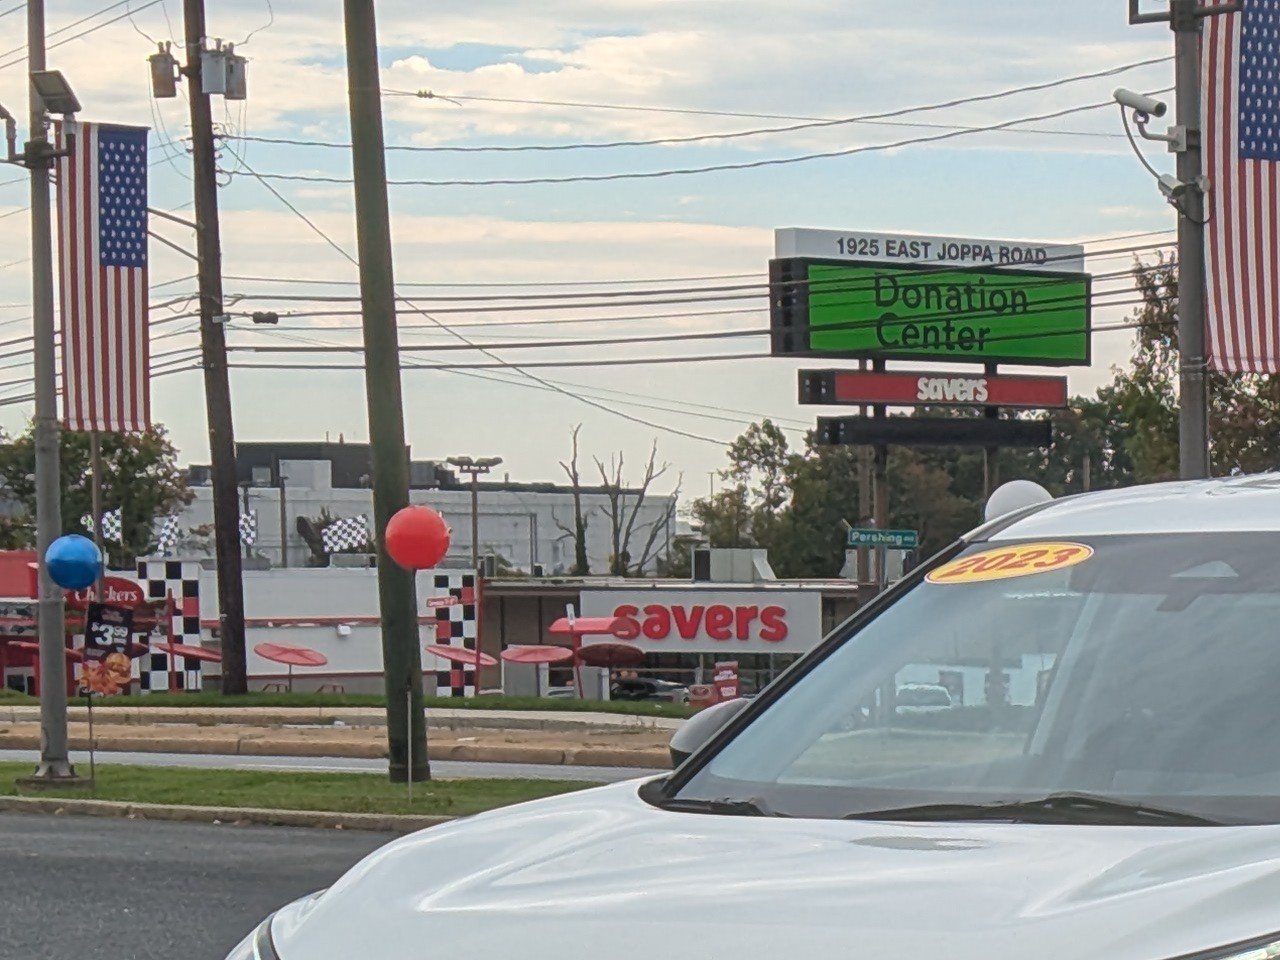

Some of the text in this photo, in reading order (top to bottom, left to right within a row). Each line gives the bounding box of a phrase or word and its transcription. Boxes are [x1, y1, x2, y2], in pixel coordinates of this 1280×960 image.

[836, 237, 1047, 265] 1925 EAST JOPPA ROAD
[874, 272, 1027, 313] Donation
[876, 312, 990, 351] Center
[917, 377, 989, 402] savers
[937, 547, 1082, 579] 2023
[73, 585, 138, 602] Chkers
[612, 603, 789, 642] savers
